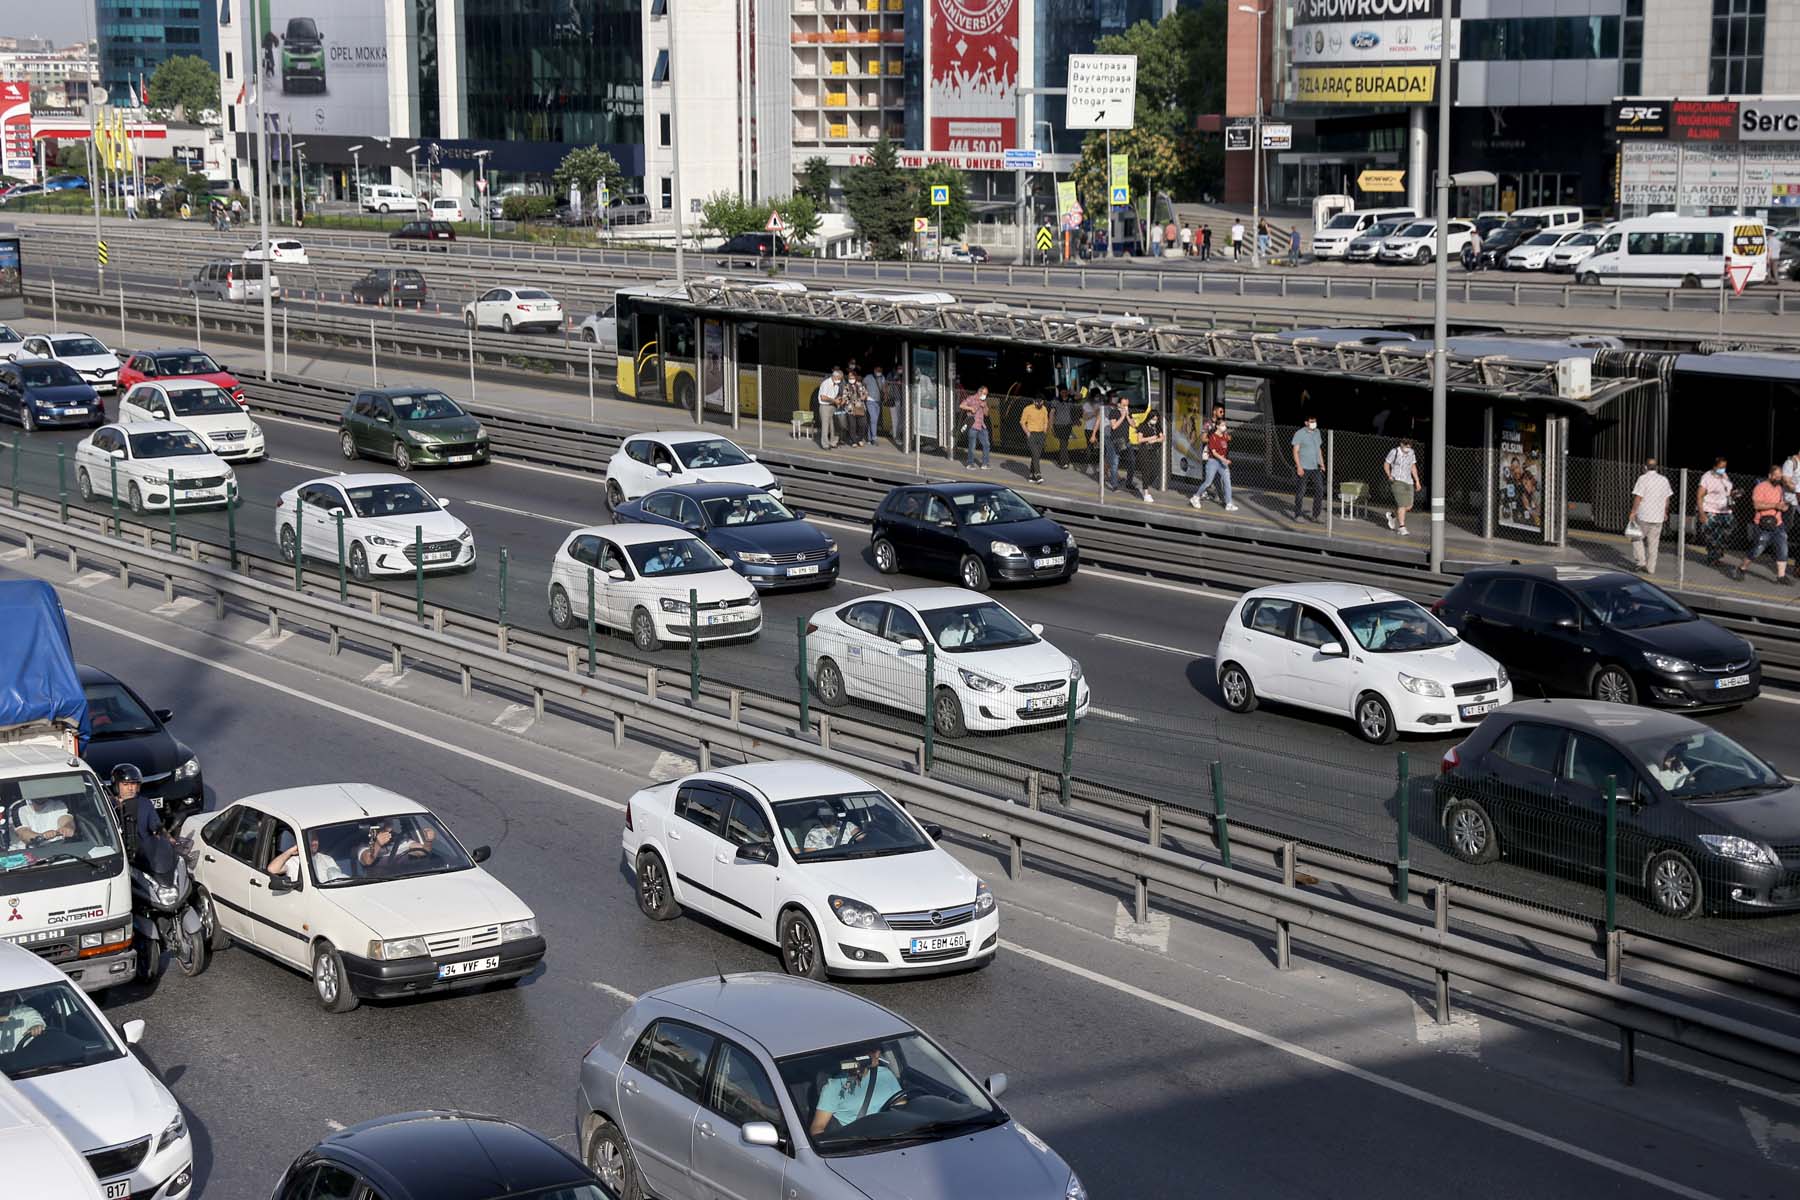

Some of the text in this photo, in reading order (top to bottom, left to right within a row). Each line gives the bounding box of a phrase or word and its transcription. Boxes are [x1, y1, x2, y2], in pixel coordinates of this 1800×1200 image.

[1310, 0, 1430, 17] SHOWROOM
[331, 47, 387, 60] OPEL MOKKA
[1073, 60, 1127, 70] Davutpaşa
[1073, 72, 1131, 83] Bayrampaşa
[1072, 85, 1131, 95] Tozkoparan
[1322, 77, 1352, 97] ARAÇ
[1356, 76, 1427, 92] BURADA!
[1071, 97, 1105, 107] Otogar
[1619, 107, 1662, 120] SRC
[1742, 109, 1798, 132] Serc
[949, 139, 969, 152] 444
[441, 147, 494, 161] PEUGET
[1624, 184, 1676, 192] SERCAN
[48, 909, 104, 924] CANTER HD
[7, 930, 65, 944] UBISHI
[918, 936, 964, 951] 34 EBM 460
[445, 958, 497, 976] 34 VVF 54
[107, 1183, 127, 1199] 817
